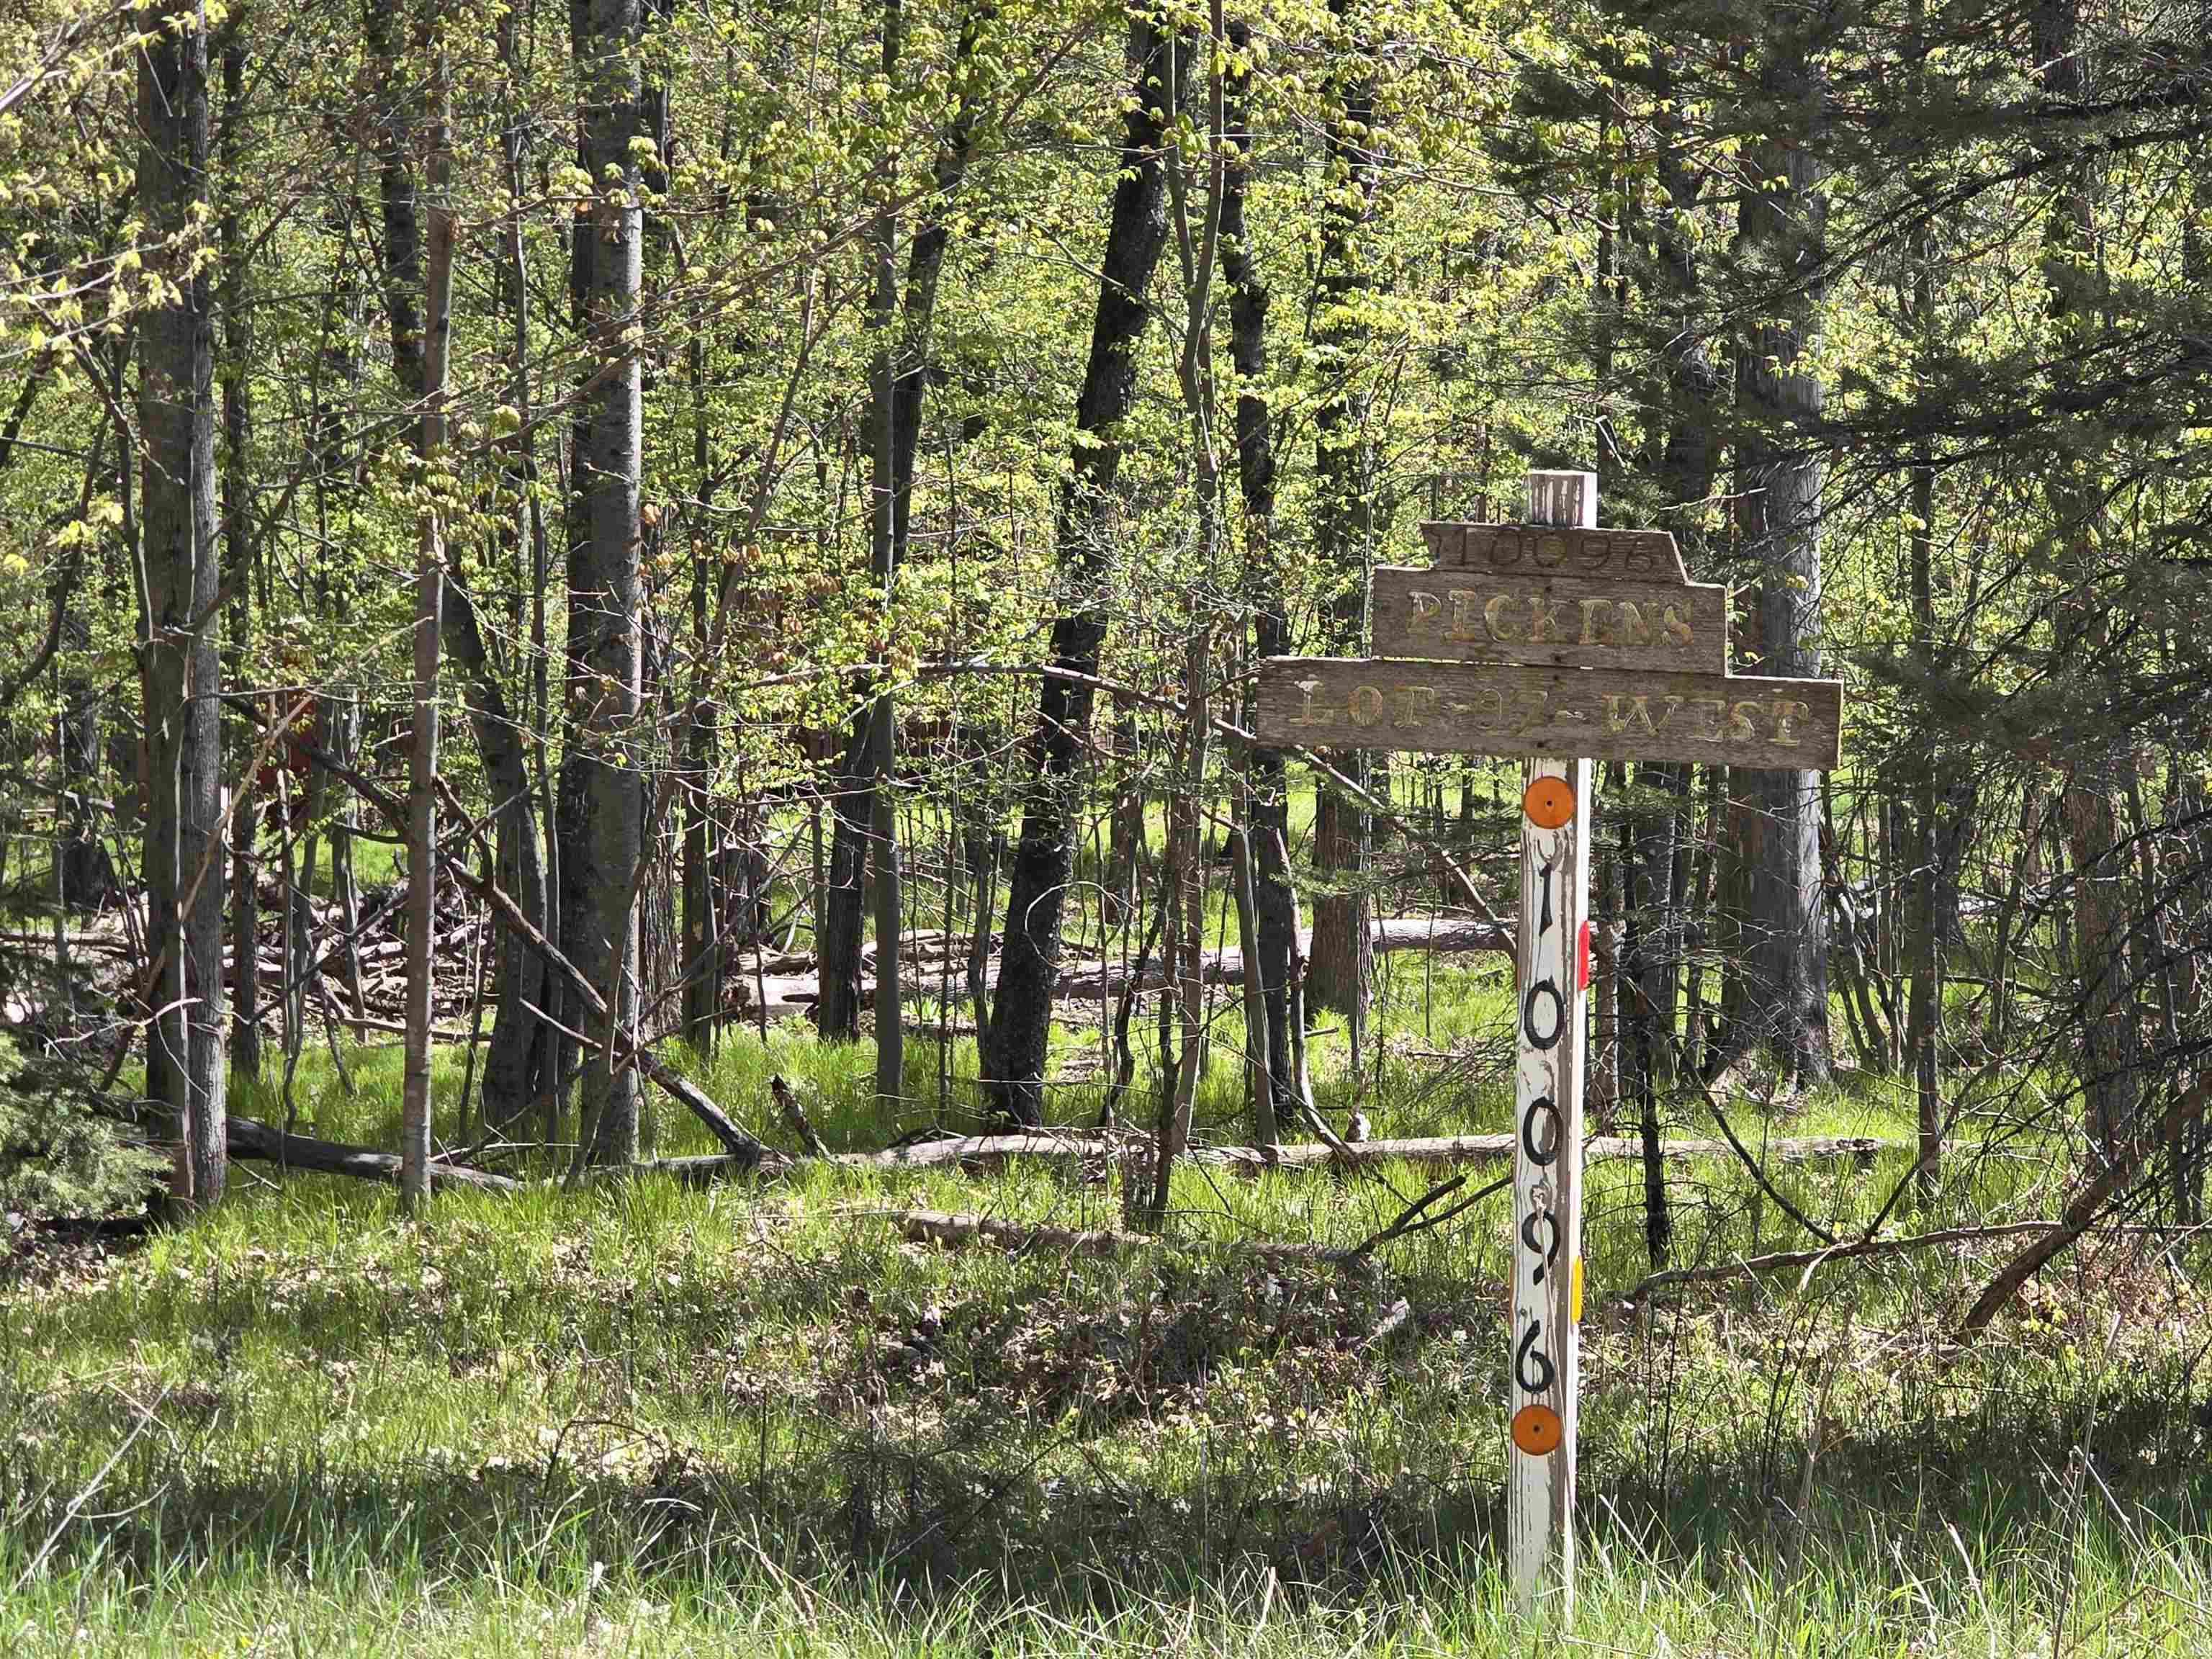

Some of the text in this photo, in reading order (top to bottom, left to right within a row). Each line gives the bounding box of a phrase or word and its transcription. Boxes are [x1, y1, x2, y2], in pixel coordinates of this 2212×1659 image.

[1455, 526, 1655, 573] 10096
[1405, 590, 1694, 649] PICKENS
[1514, 862, 1565, 1394] 10096
